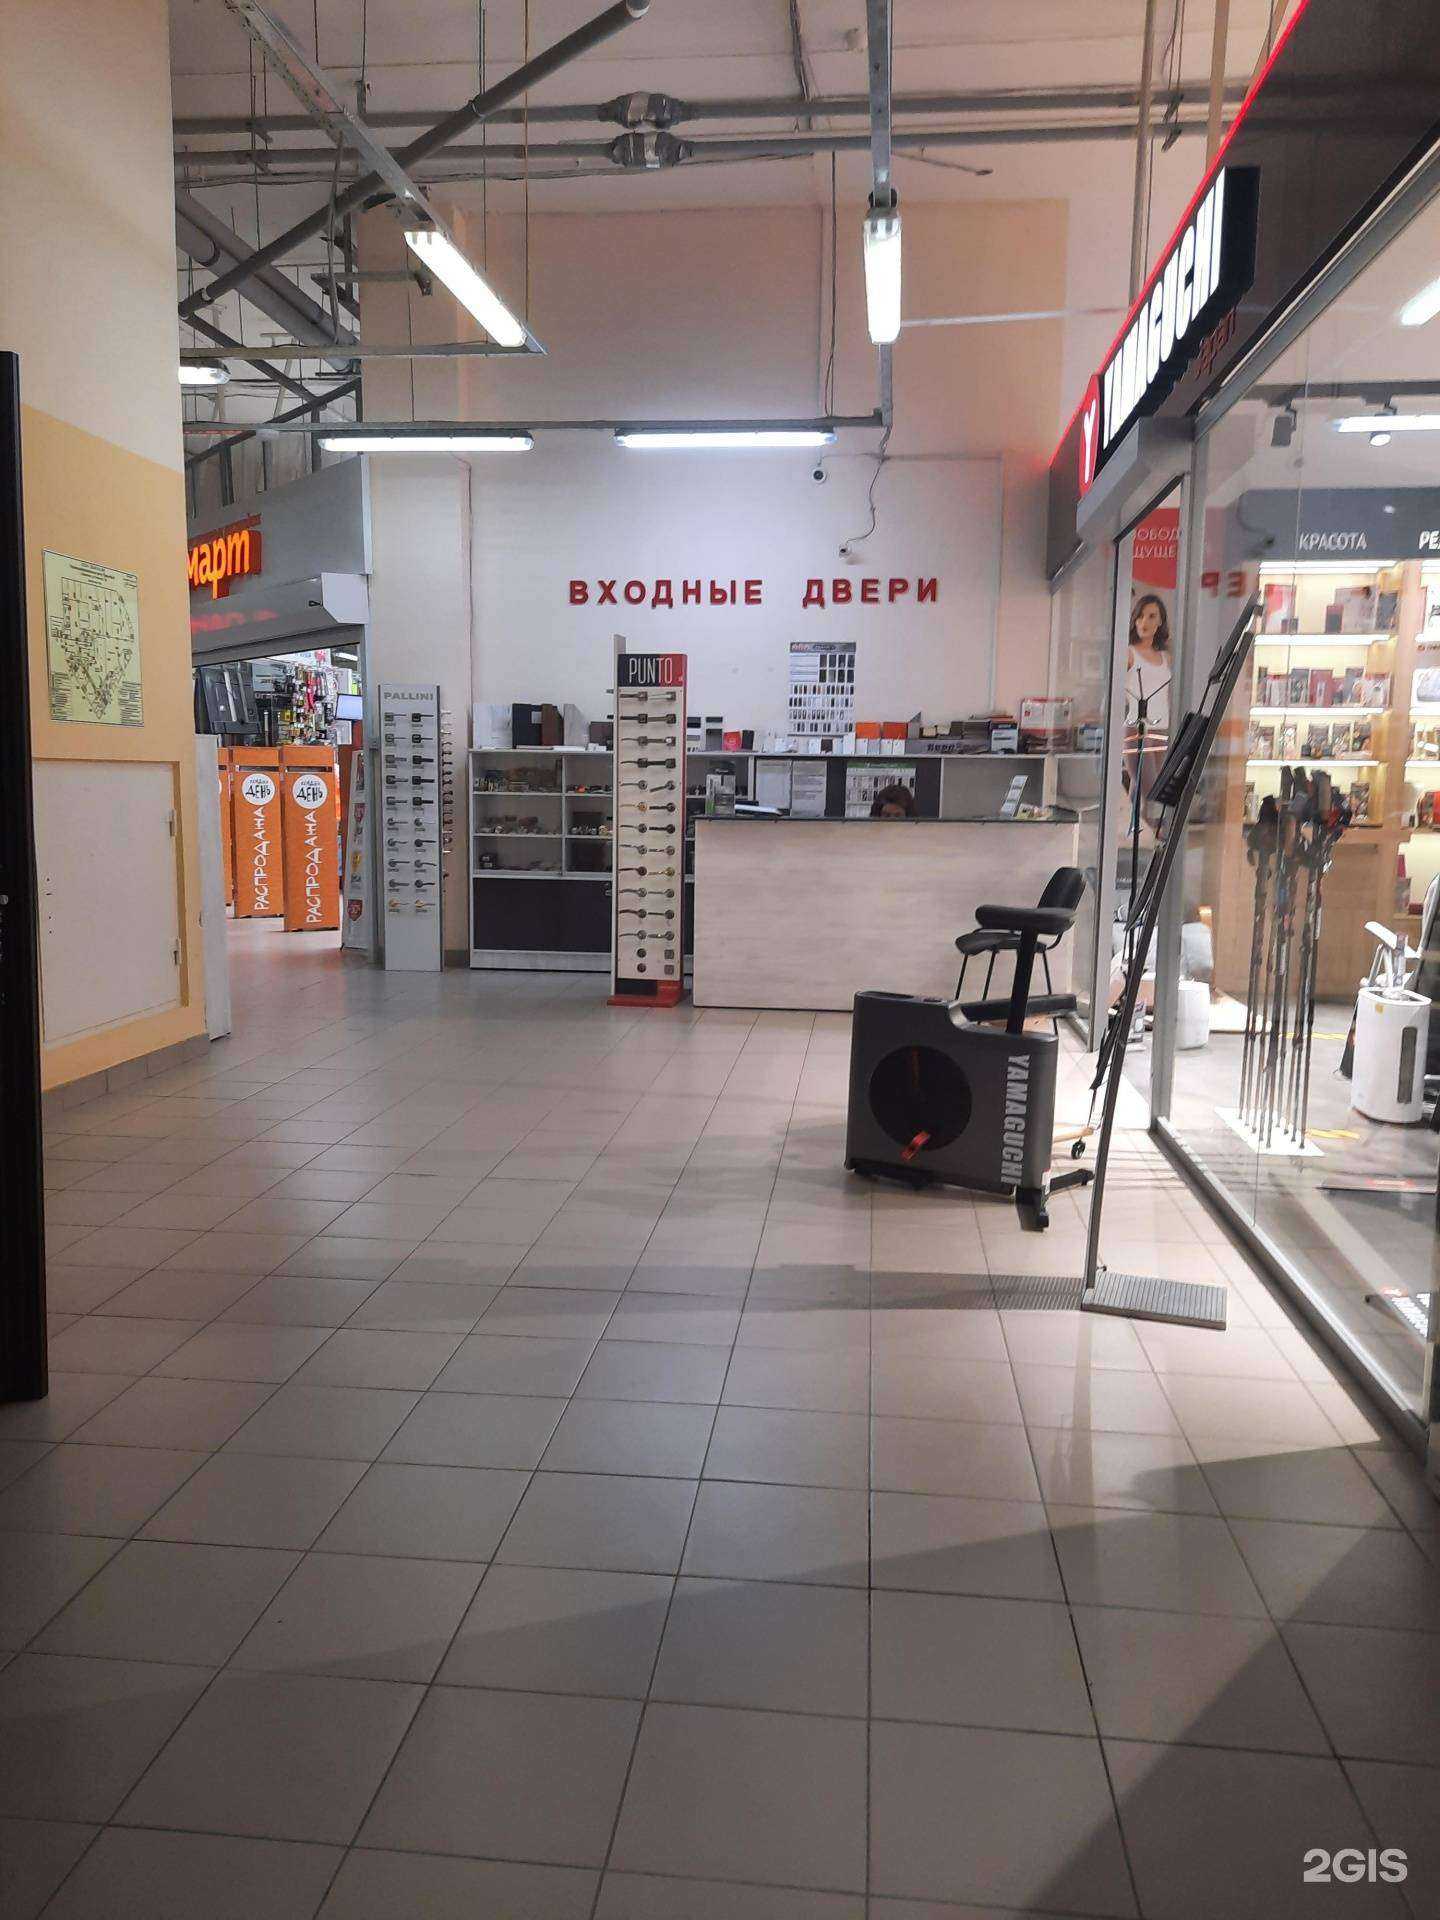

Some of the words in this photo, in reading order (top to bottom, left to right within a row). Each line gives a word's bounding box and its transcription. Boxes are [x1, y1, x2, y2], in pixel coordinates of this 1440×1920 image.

[1299, 531, 1368, 551] КРАСОТА
[1418, 530, 1440, 550] РЕ
[569, 578, 764, 609] ВХОДНЫЕ
[802, 577, 939, 609] ДВЕРИ
[628, 657, 673, 684] PUNTO
[383, 692, 434, 701] PALLINI
[245, 784, 271, 799] ДЕНЬ
[296, 786, 323, 802] ДЕНЬ
[253, 806, 271, 910] РАСПРОДАЖА
[304, 810, 323, 923] РАСПРОДАЖА
[1000, 1053, 1031, 1187] YAMAGUCHI
